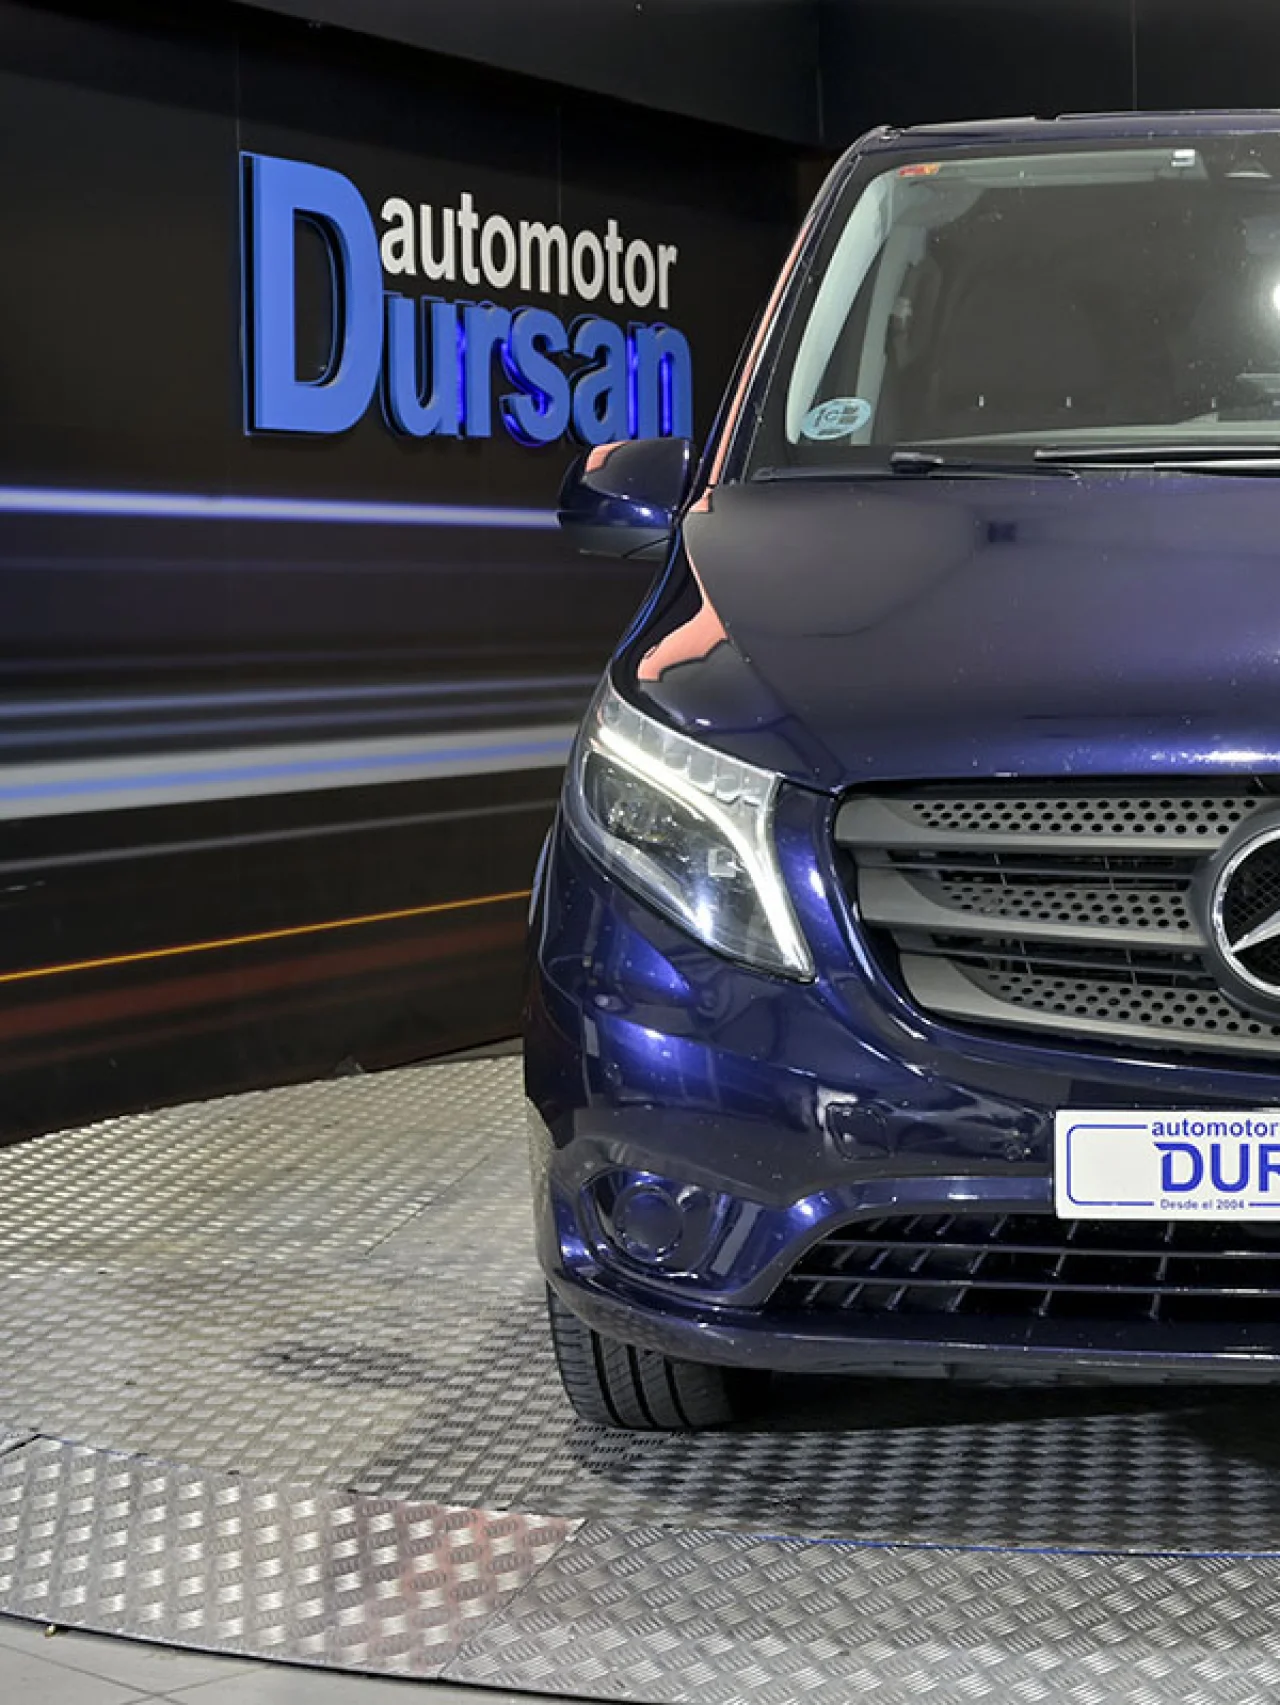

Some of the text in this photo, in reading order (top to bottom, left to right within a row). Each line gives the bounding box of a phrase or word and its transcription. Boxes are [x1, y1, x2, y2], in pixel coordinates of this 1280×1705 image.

[380, 190, 678, 309] automotor
[239, 150, 693, 448] Dursan
[1151, 1119, 1279, 1137] automotor
[1159, 1198, 1198, 1210] Desde
[1201, 1198, 1213, 1210] el
